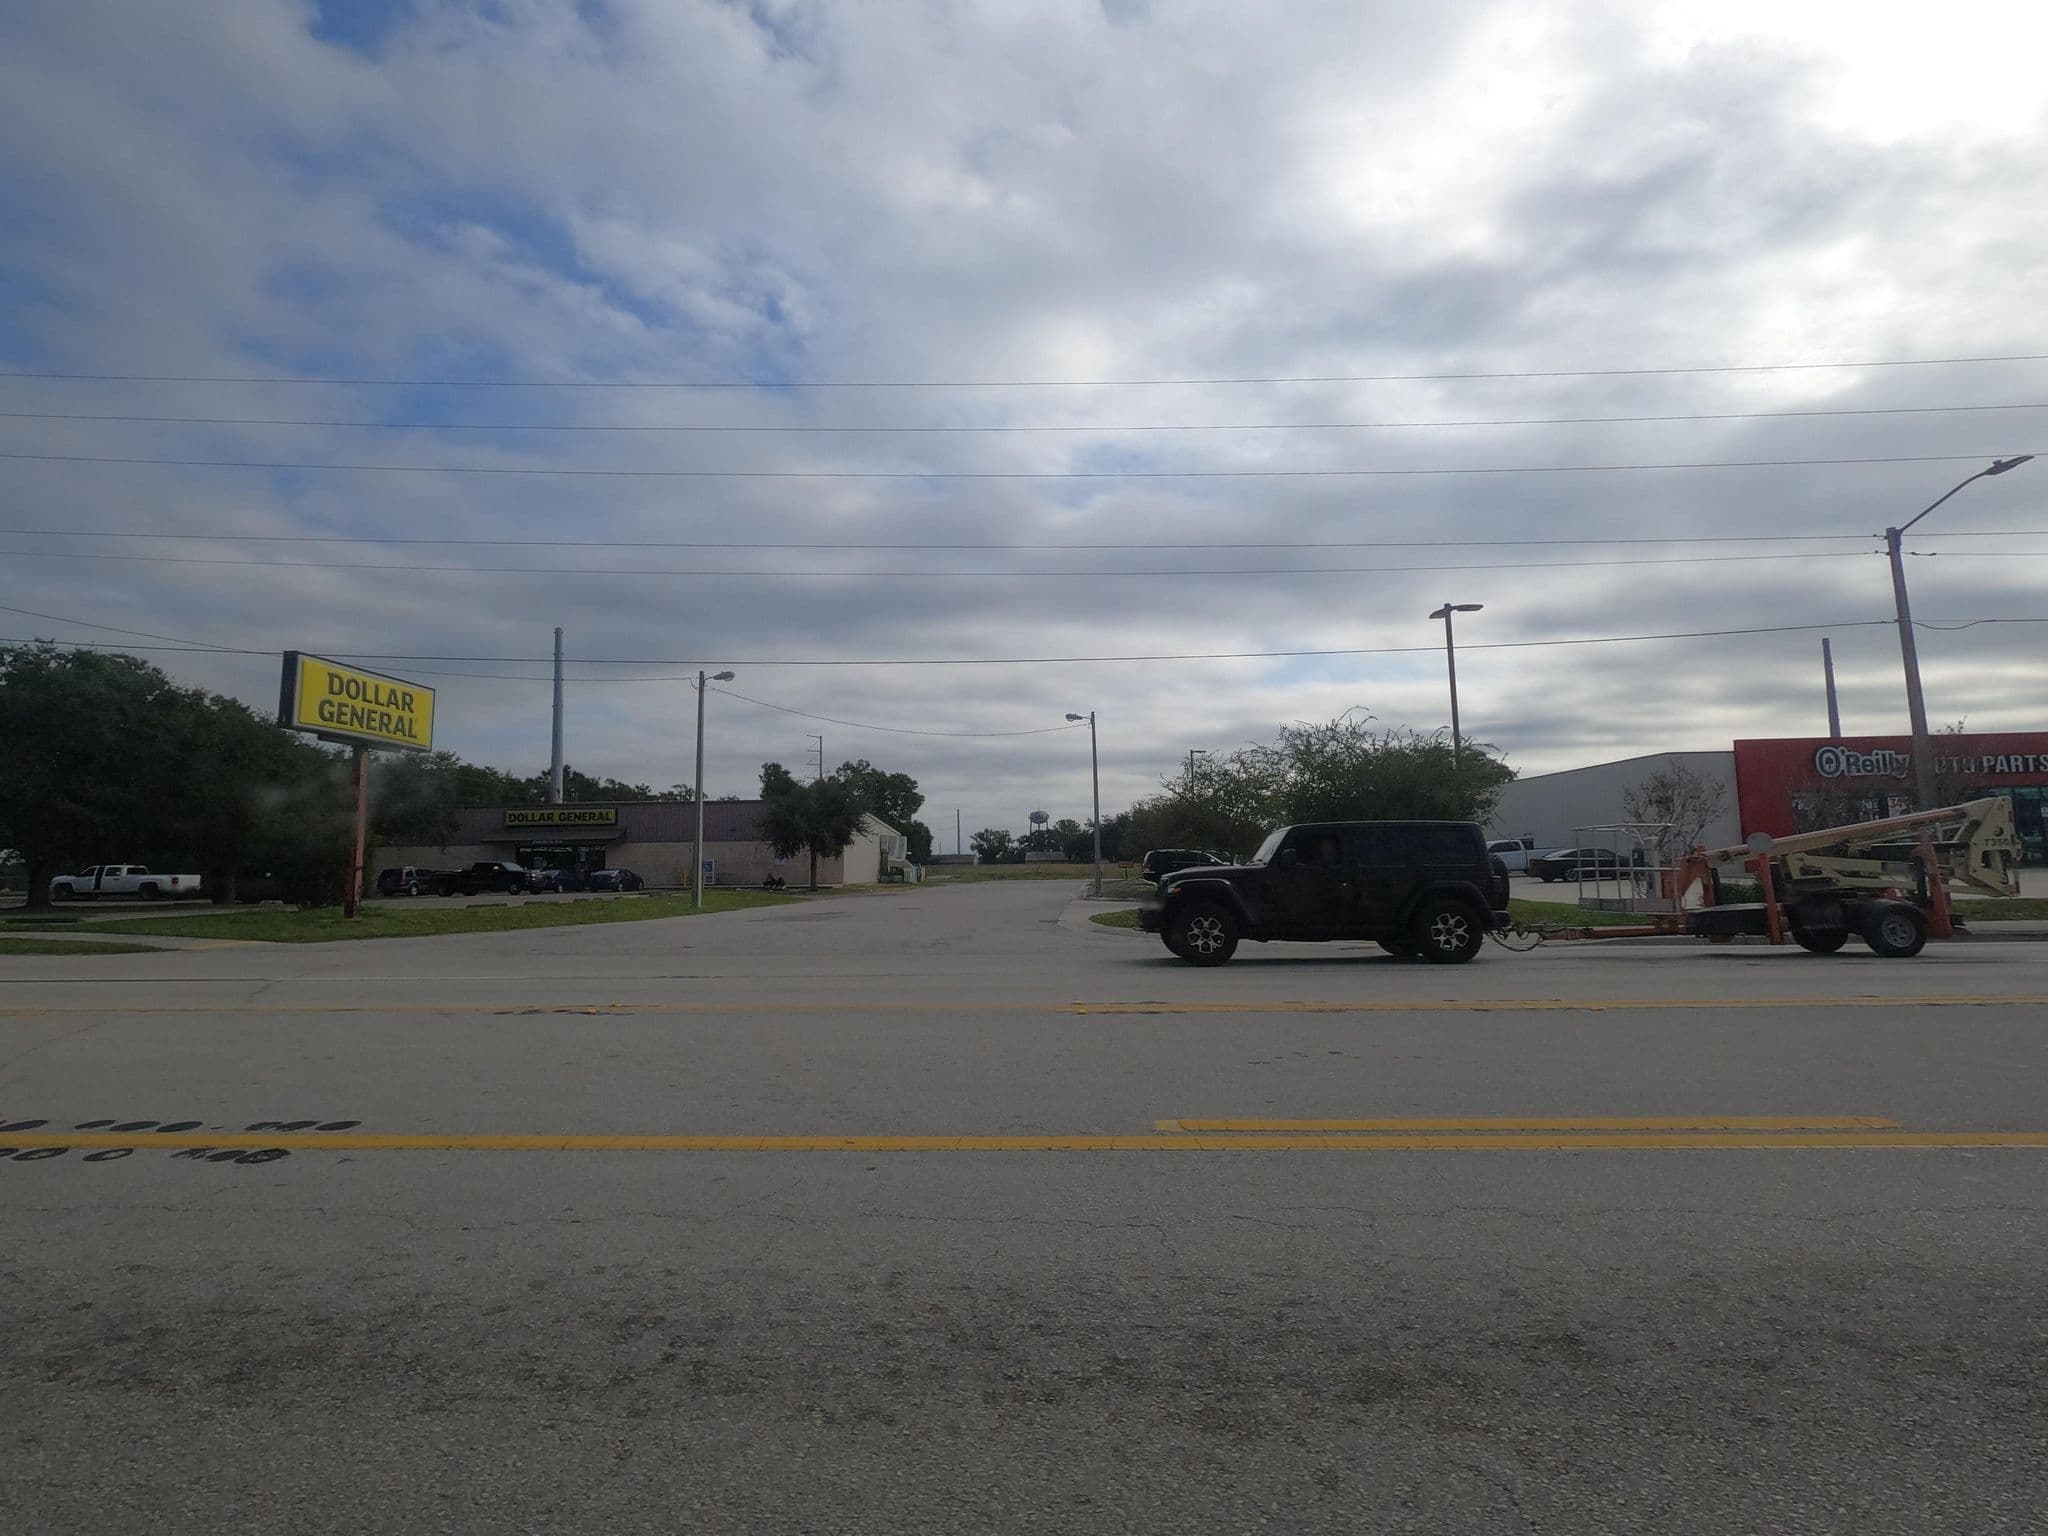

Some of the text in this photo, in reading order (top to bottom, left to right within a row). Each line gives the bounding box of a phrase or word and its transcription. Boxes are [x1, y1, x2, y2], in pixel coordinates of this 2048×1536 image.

[327, 672, 414, 714] DOLLAR
[318, 698, 417, 739] GENERAL
[1816, 747, 1910, 779] O'Reilly
[1982, 754, 2048, 773] PARTS
[508, 811, 612, 823] DOLLAR GENERAL
